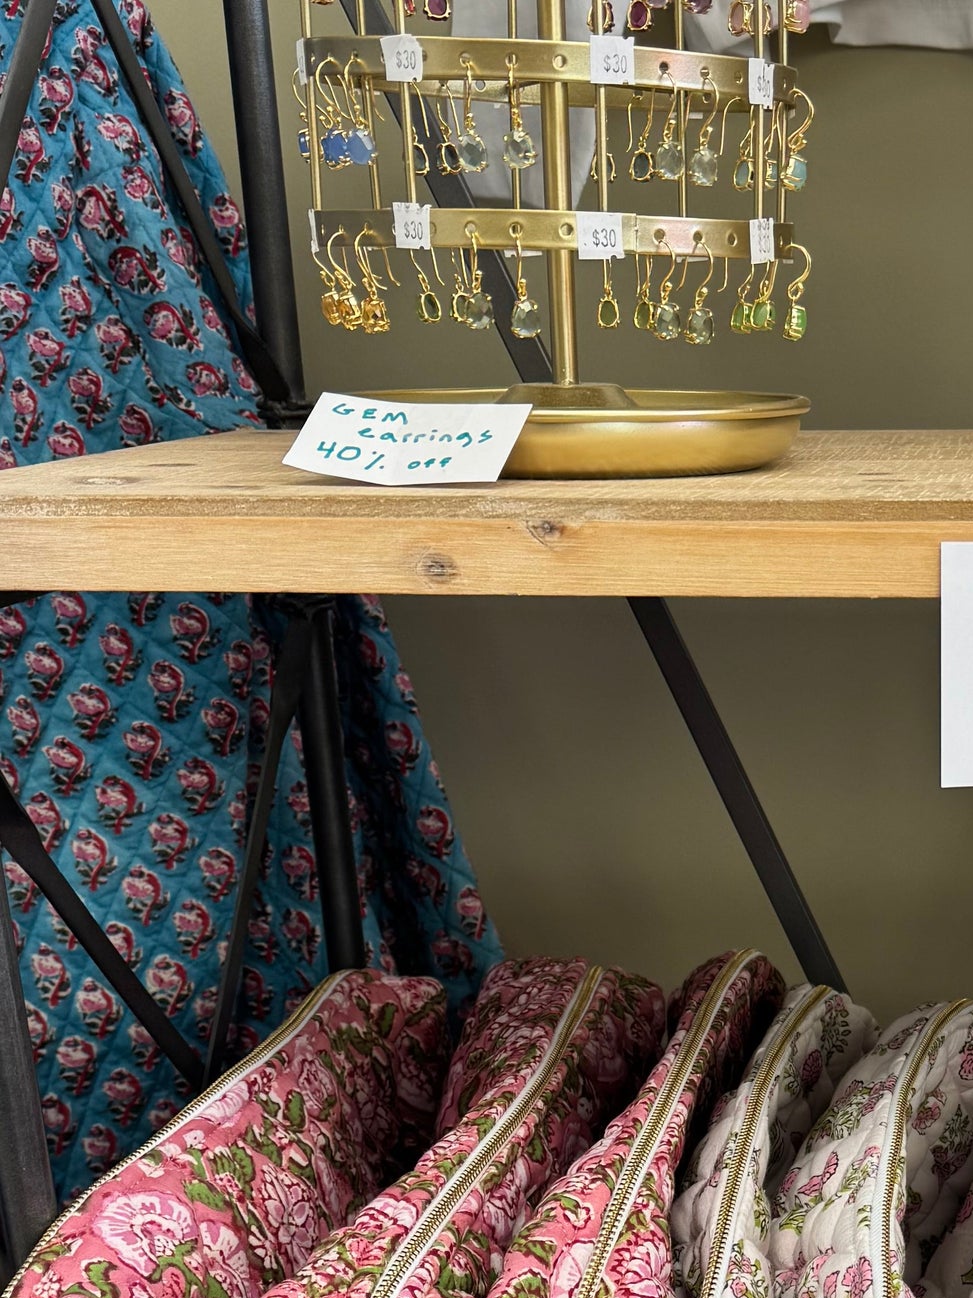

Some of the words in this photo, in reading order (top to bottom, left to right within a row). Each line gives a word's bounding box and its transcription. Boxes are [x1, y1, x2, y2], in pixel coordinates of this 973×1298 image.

[395, 50, 417, 70] $30
[603, 54, 628, 74] $30
[404, 220, 424, 241] $30
[592, 228, 617, 248] $30
[332, 402, 409, 425] GEM
[357, 427, 493, 448] earrings
[316, 440, 386, 470] 40%
[407, 456, 452, 470] off
